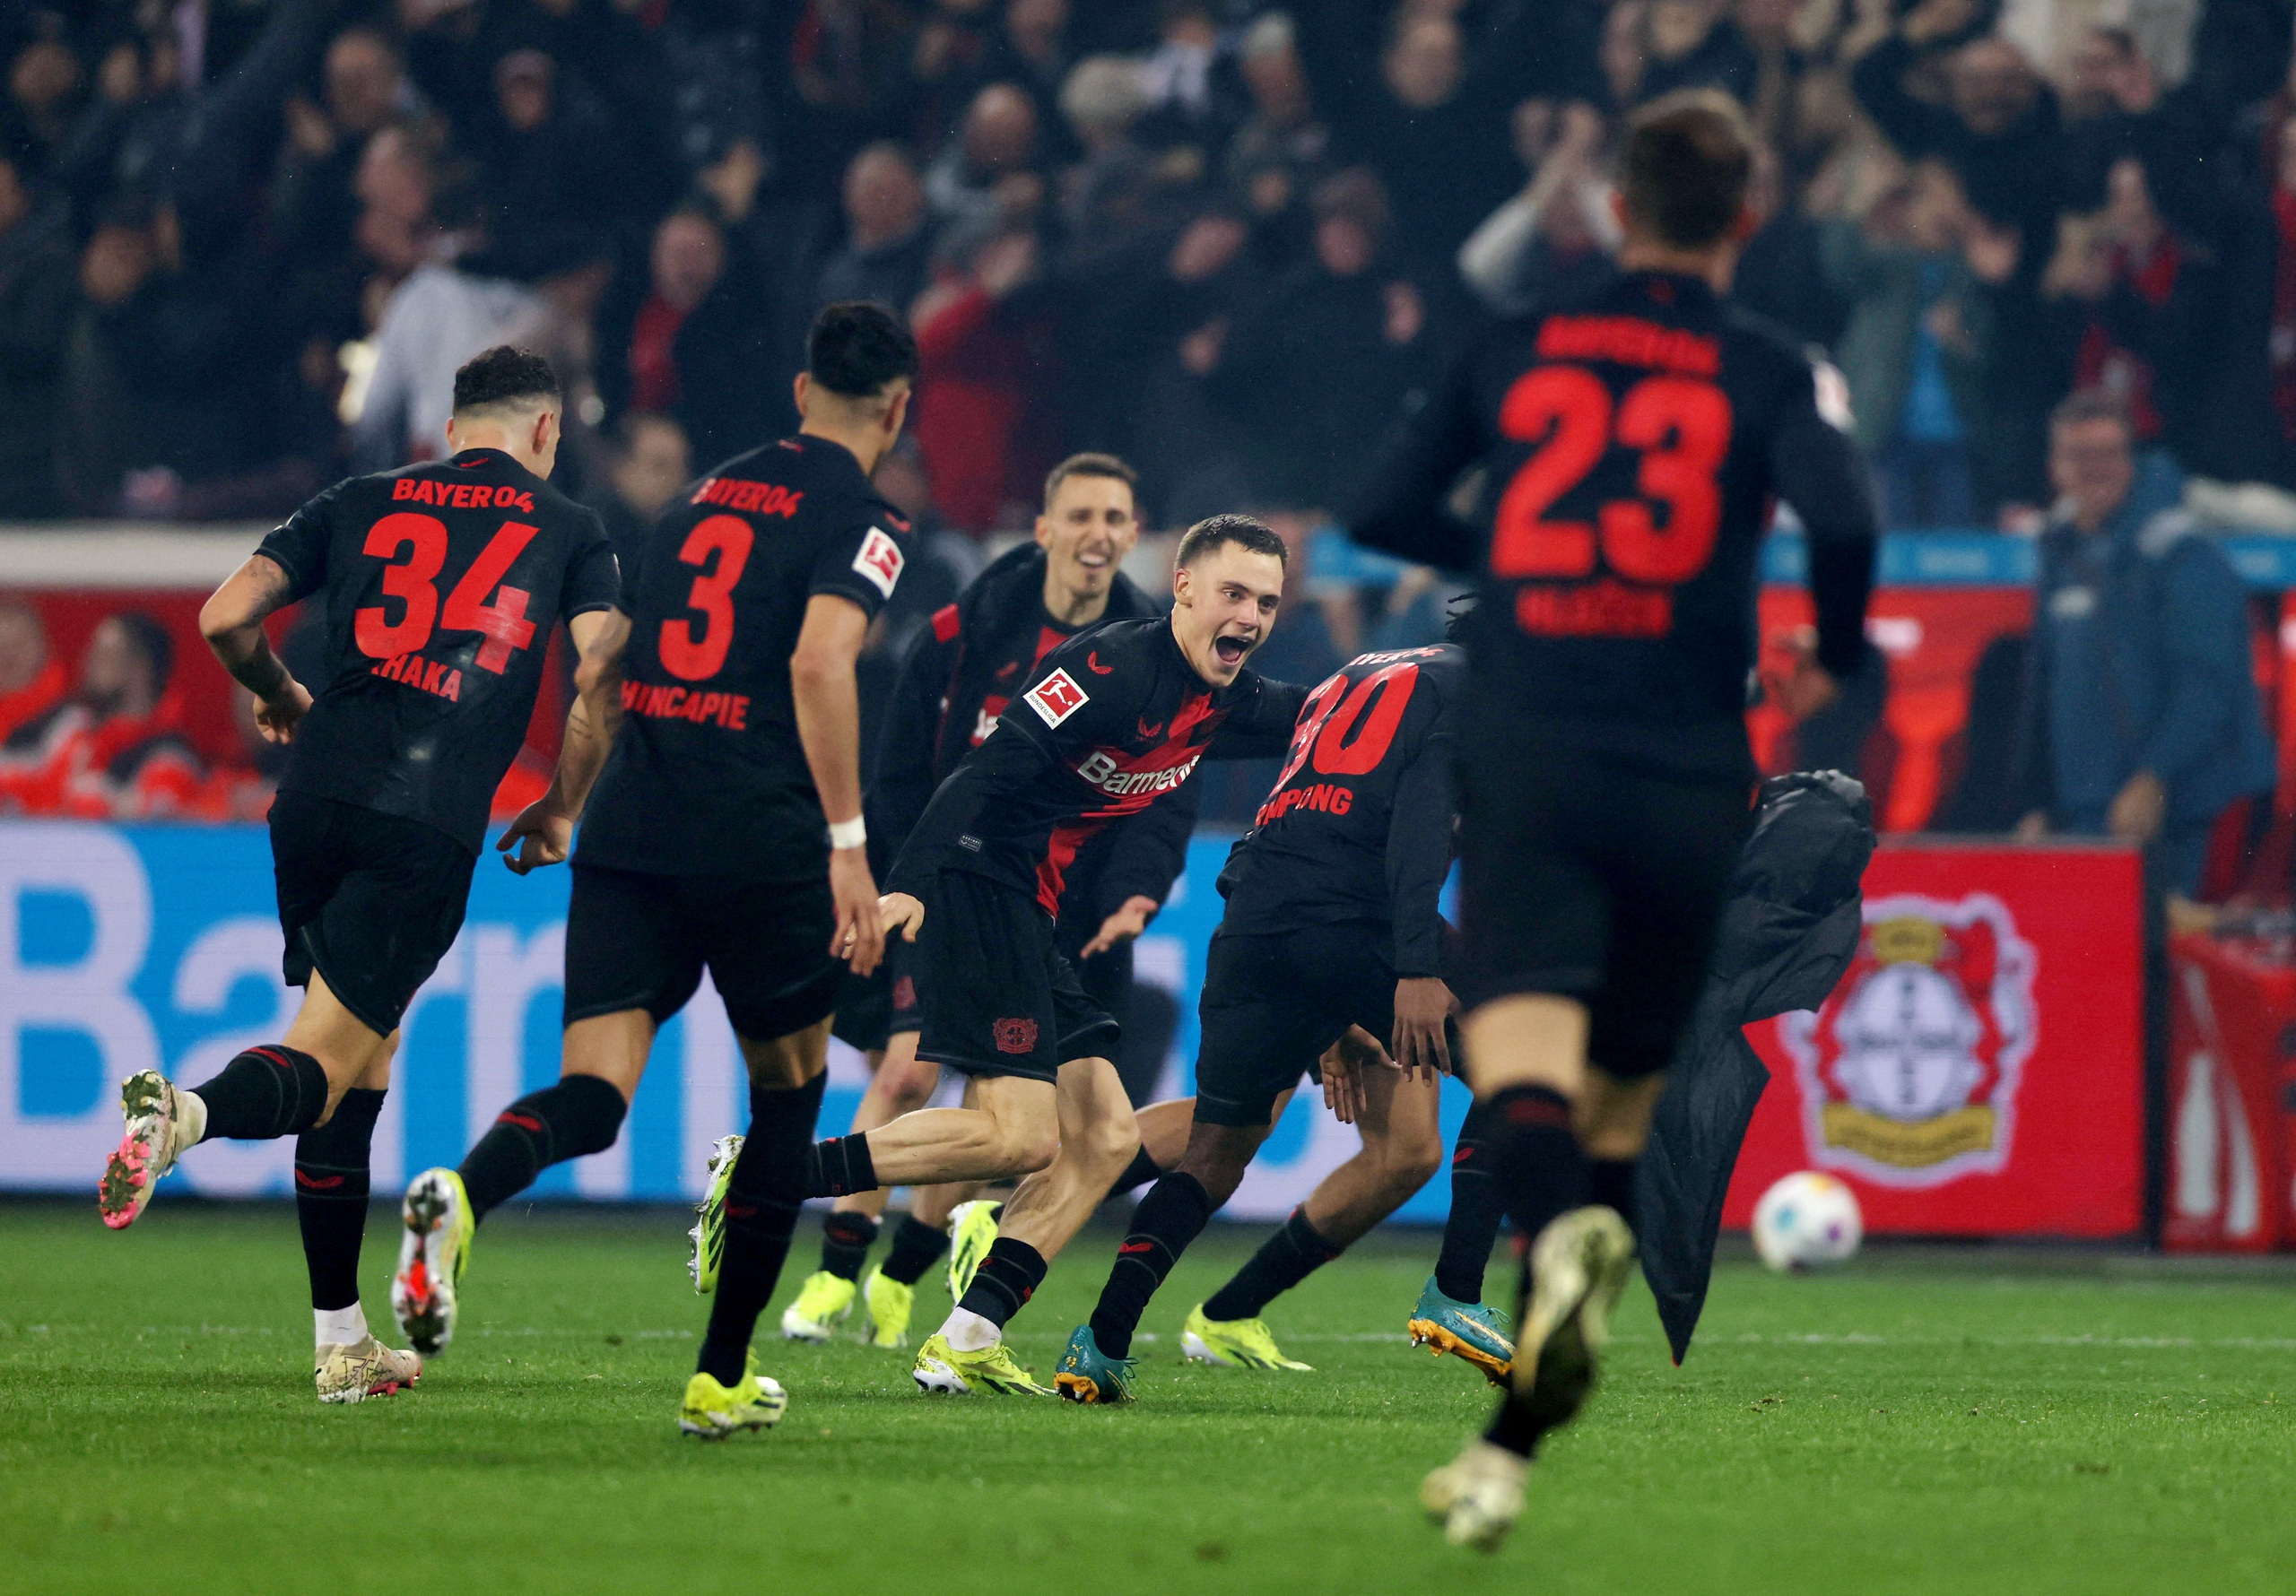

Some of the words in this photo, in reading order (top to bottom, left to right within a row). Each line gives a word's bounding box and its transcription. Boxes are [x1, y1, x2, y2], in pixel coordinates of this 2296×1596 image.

[393, 478, 535, 515] BAYER04
[1490, 362, 1734, 585] 23
[354, 512, 540, 676] 34
[658, 513, 755, 682] 3
[370, 654, 463, 703] HAKA
[1029, 694, 1057, 724] BUNDESLIGA
[1077, 750, 1201, 794] Barmeni
